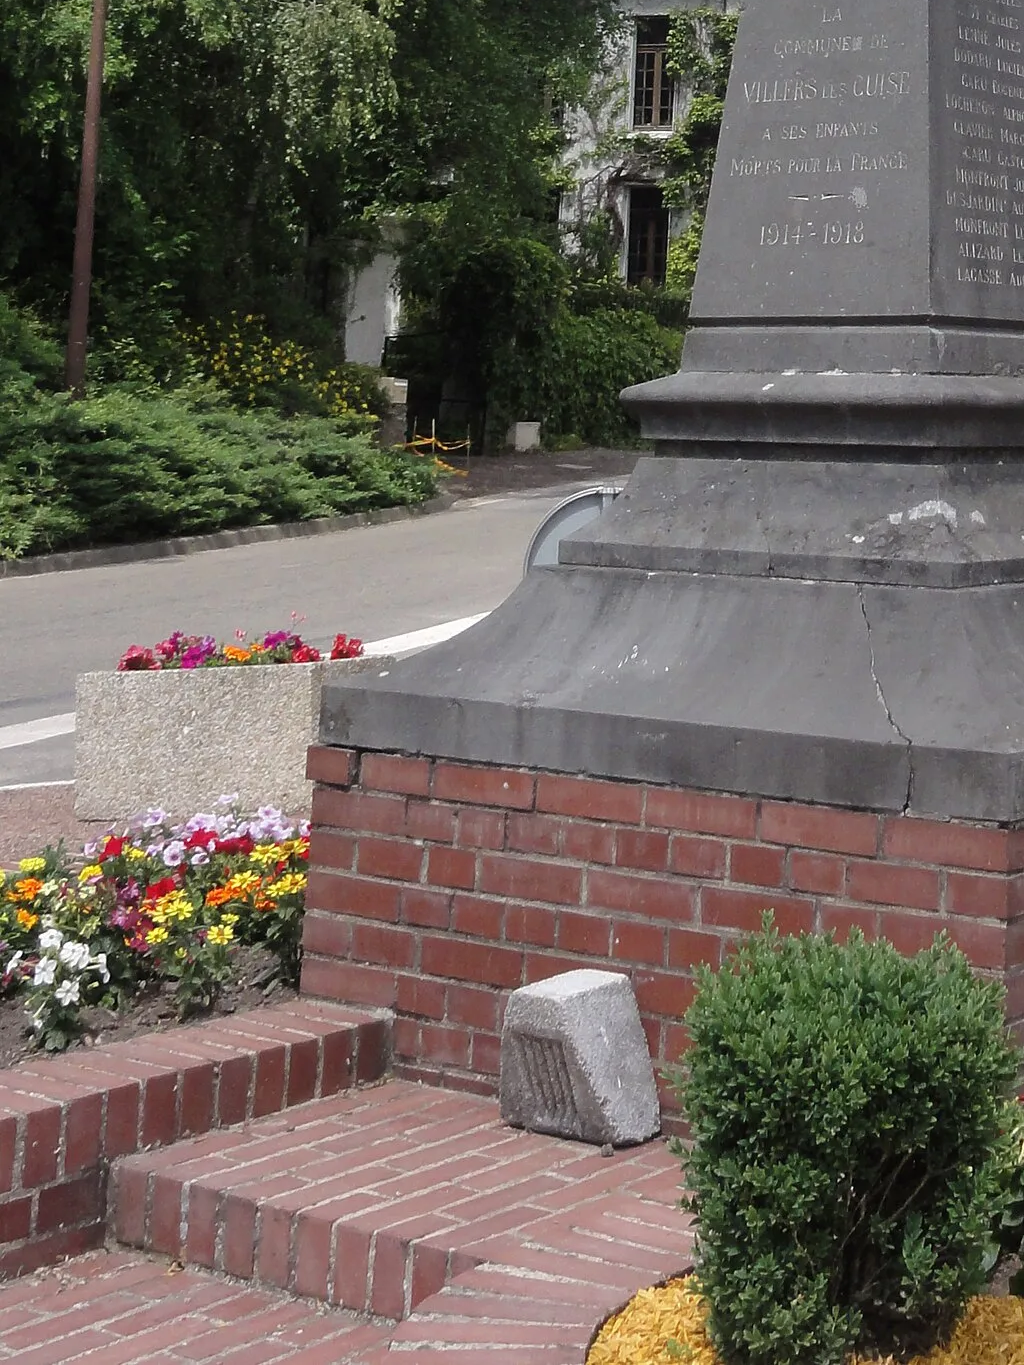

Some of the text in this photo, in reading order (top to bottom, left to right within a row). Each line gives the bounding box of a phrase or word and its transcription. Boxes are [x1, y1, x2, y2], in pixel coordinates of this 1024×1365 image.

[822, 7, 842, 23] LA
[743, 78, 817, 103] VILLERS
[781, 125, 807, 140] SES
[815, 121, 878, 139] ENFANTS
[787, 157, 820, 174] POUR
[826, 155, 842, 173] LA
[850, 151, 908, 172] FRANCE
[955, 217, 1008, 238] MONFRONT
[957, 267, 1002, 285] LACASSE
